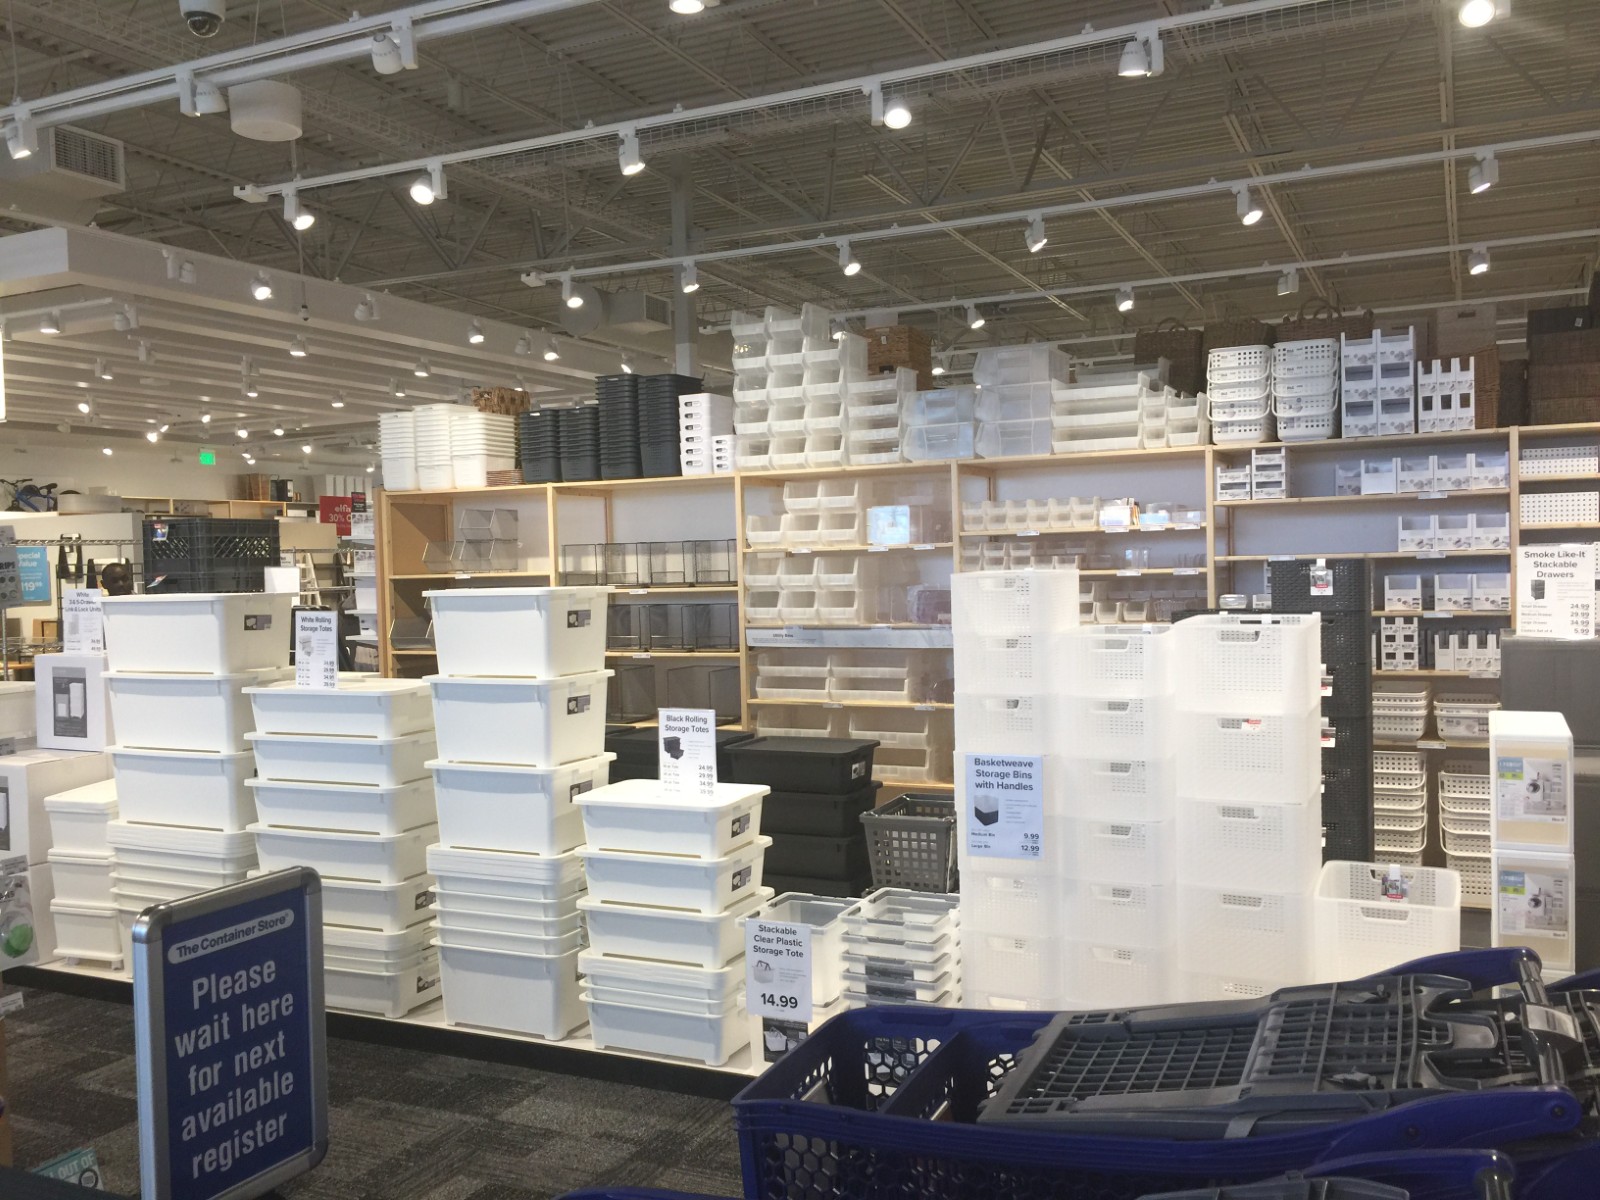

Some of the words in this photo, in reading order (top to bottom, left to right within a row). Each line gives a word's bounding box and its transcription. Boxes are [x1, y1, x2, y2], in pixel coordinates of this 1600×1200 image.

[17, 552, 41, 560] pecial
[315, 616, 332, 624] Rolling
[666, 714, 684, 722] Black
[685, 715, 708, 724] Rolling
[664, 724, 689, 733] Storage
[691, 725, 709, 733] Totes
[974, 757, 1034, 767] Basketweave
[975, 769, 1011, 779] Storage
[1012, 770, 1033, 779] Bins
[975, 780, 994, 789] with
[996, 781, 1034, 791] Handles
[758, 924, 797, 936] Stackable
[176, 943, 199, 958] The
[200, 924, 257, 951] Container
[753, 934, 775, 944] Clear
[776, 936, 803, 947] Plastic
[753, 945, 784, 956] Storage
[785, 948, 804, 958] Tote
[192, 960, 276, 1010] Please
[760, 992, 799, 1009] 14.99
[174, 1011, 231, 1058] wait
[241, 993, 294, 1033] here
[188, 1061, 223, 1096] for
[234, 1030, 286, 1077] next
[181, 1070, 294, 1141] available
[192, 1112, 288, 1179] register
[57, 1160, 80, 1179] OUT
[80, 1153, 95, 1168] OF
